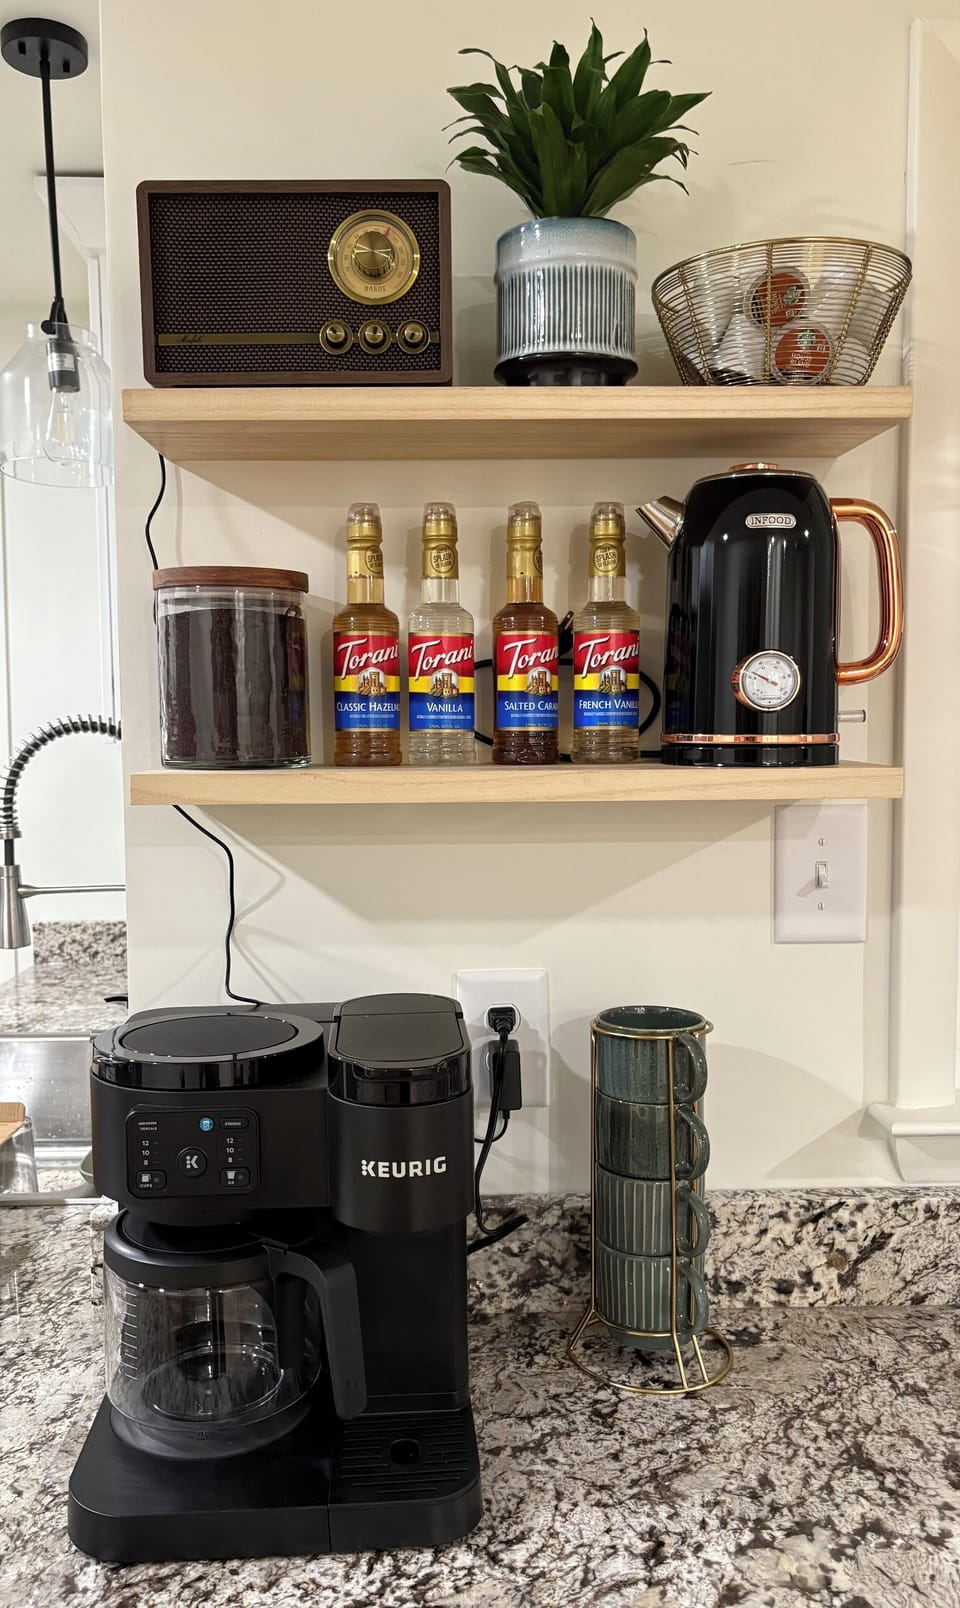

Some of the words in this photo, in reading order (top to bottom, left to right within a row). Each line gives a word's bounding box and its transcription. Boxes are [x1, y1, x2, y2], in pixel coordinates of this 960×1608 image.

[751, 516, 792, 525] INFOOD
[337, 638, 399, 680] Torani
[411, 639, 473, 680] Torani
[336, 702, 367, 712] CLASSIC
[426, 702, 464, 713] VANILLA
[504, 700, 536, 711] SALTED
[579, 699, 612, 710] FRENCH
[361, 1156, 447, 1178] KEURIG
